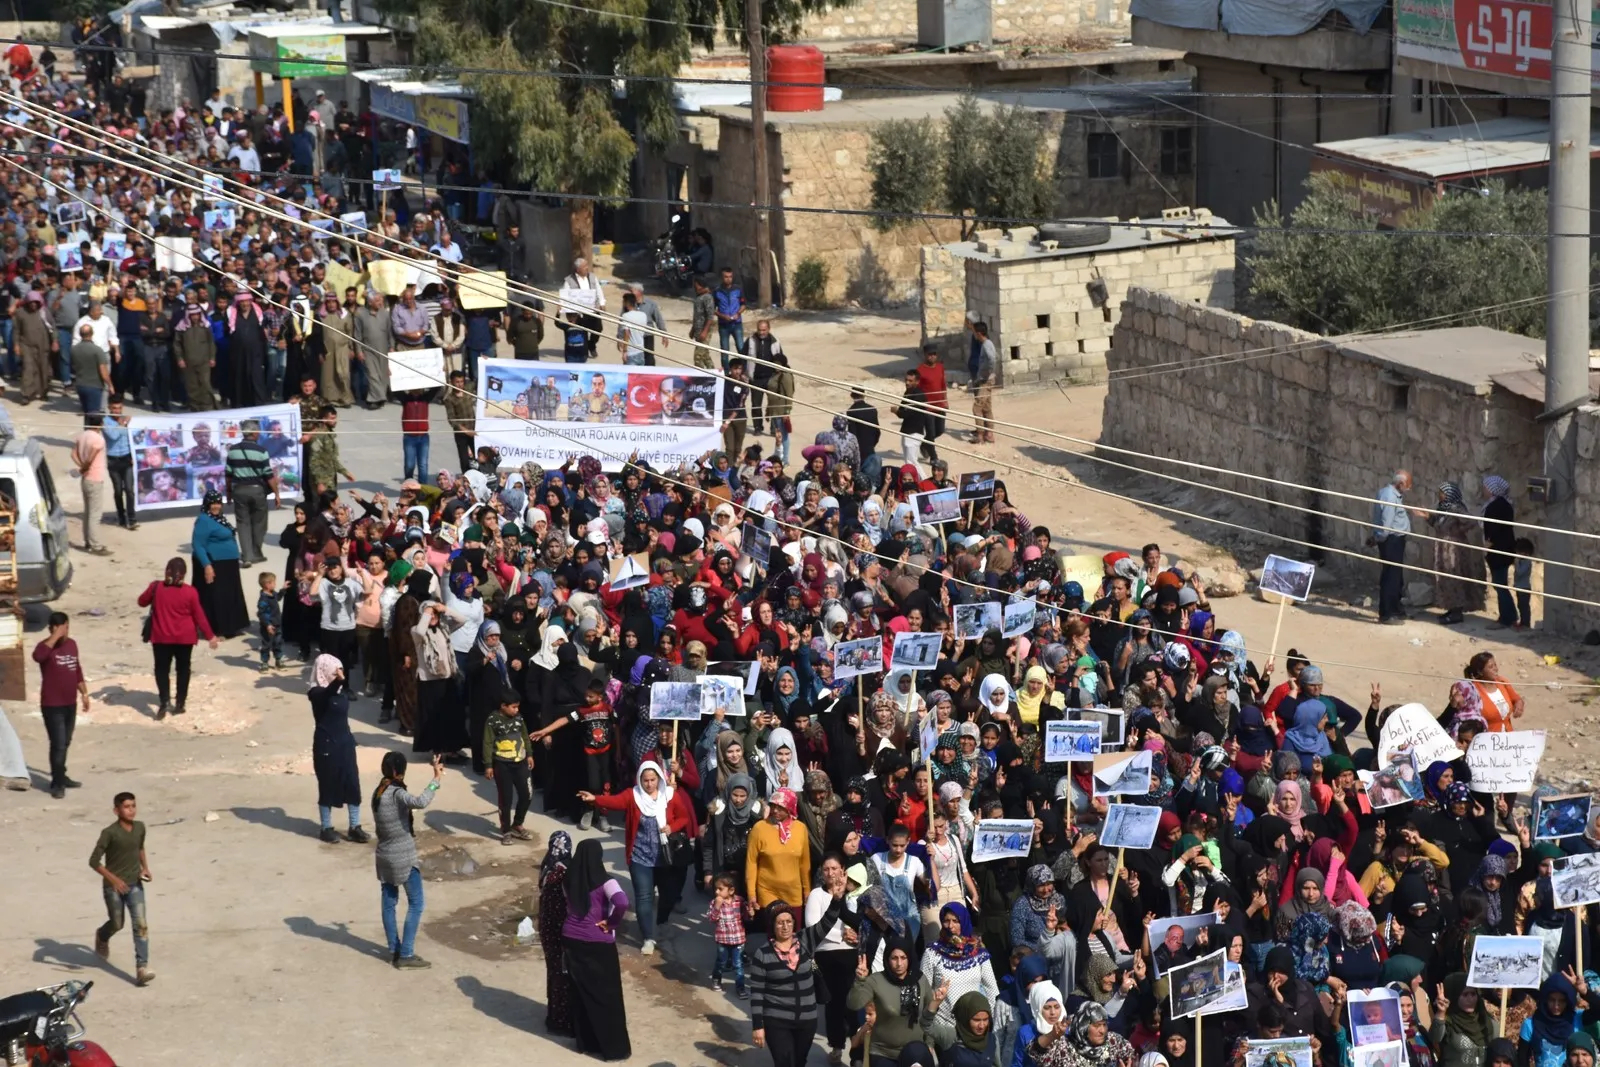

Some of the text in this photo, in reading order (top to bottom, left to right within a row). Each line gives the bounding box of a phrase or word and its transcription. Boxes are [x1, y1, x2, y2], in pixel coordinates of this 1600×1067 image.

[589, 429, 627, 441] ROJAVA
[629, 431, 679, 443] QIRKIRINA
[1472, 735, 1487, 751] Em
